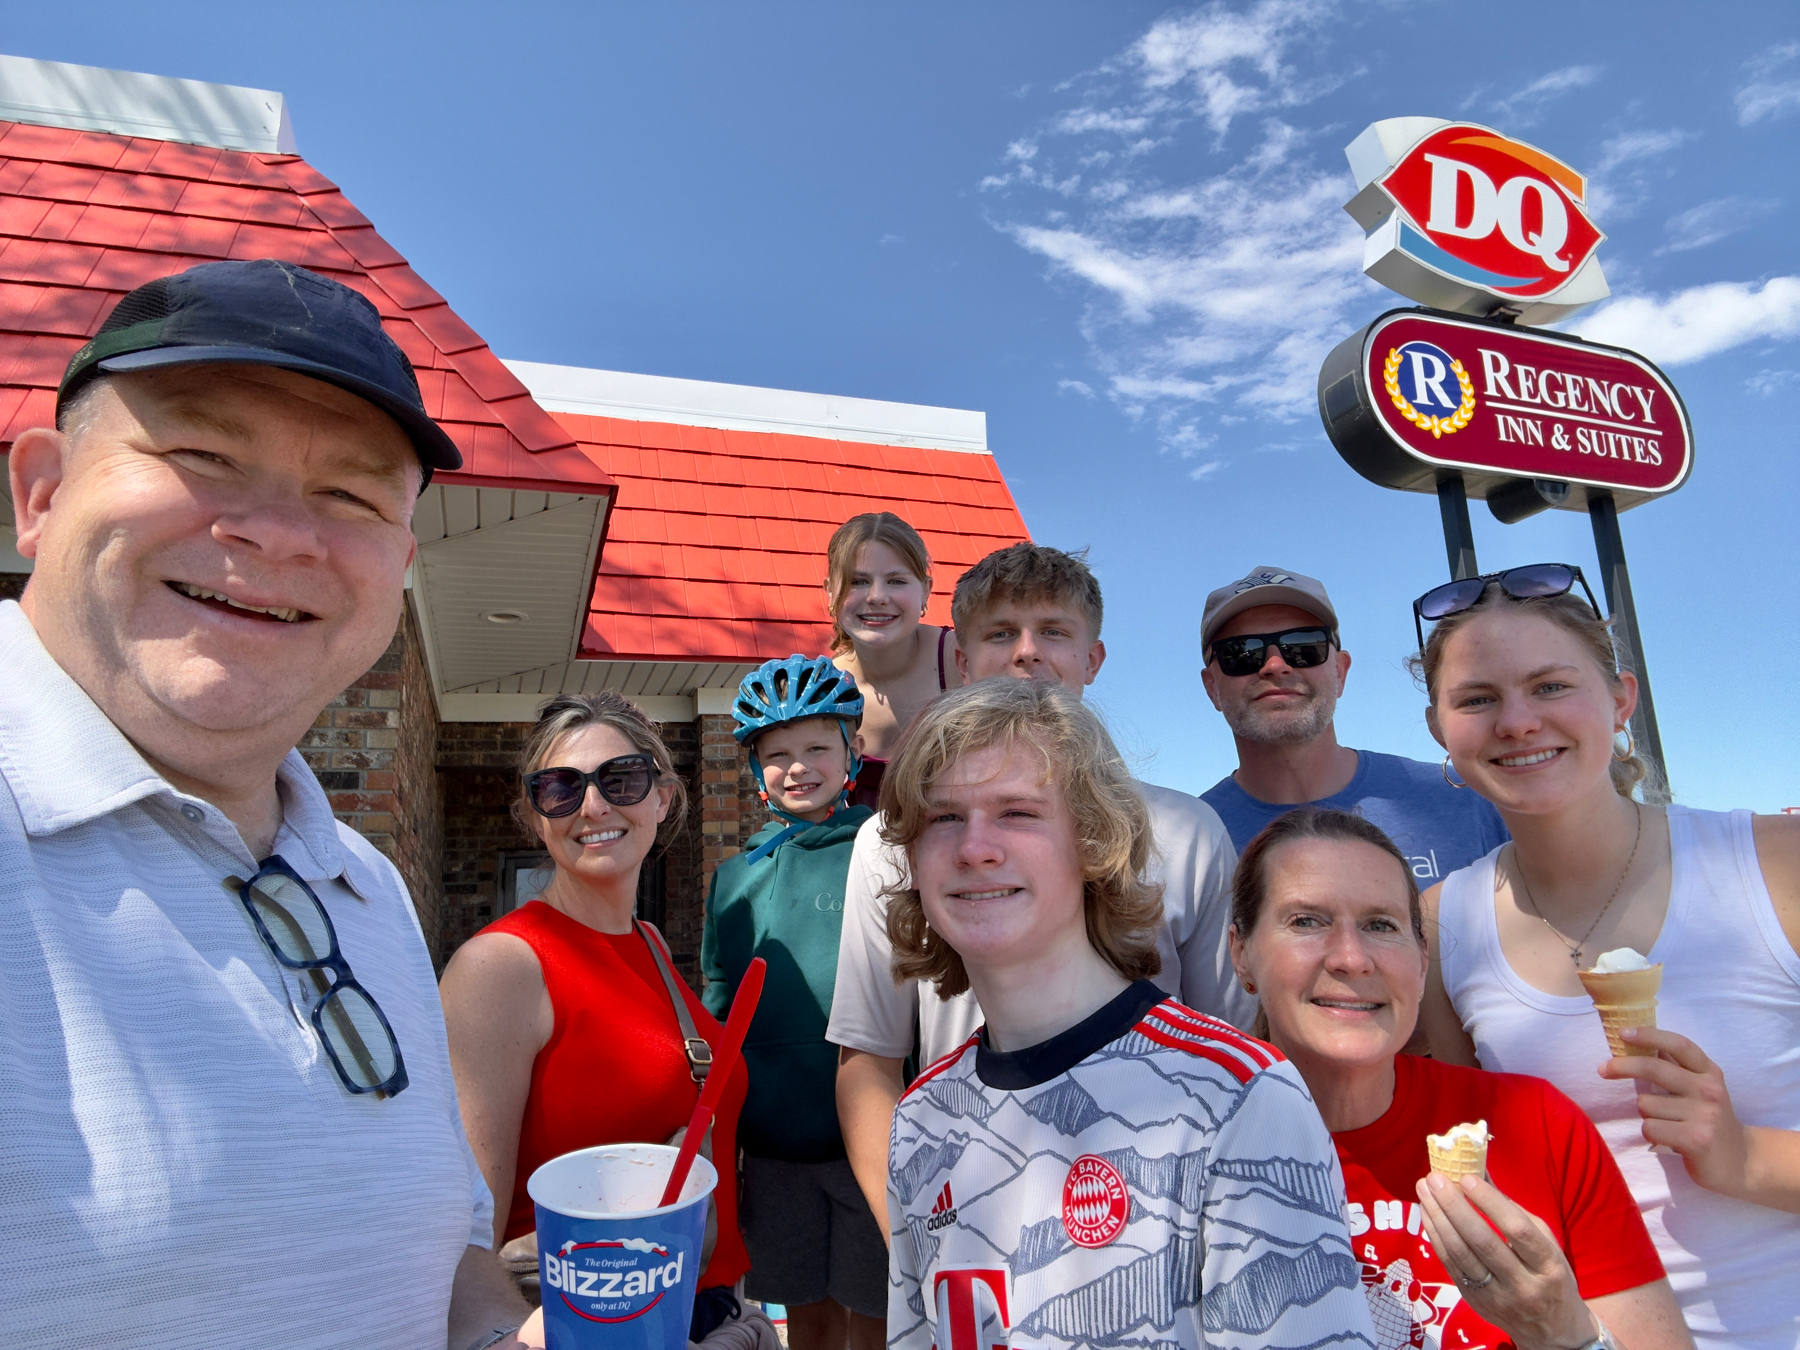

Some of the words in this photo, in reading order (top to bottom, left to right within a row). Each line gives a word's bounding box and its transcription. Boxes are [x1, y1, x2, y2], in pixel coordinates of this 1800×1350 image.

[1424, 153, 1570, 272] DQ
[1405, 350, 1458, 409] R
[1477, 348, 1656, 424] REGENCY
[1494, 414, 1545, 447] INN
[1551, 423, 1572, 451] &
[1576, 427, 1663, 466] SUITES
[1404, 849, 1440, 878] al
[814, 892, 844, 912] Co
[1067, 1170, 1078, 1190] FC
[1078, 1161, 1123, 1200] BAYERN
[927, 1208, 957, 1231] adidas
[545, 1251, 684, 1298] Blizzard
[585, 1257, 600, 1267] The
[601, 1257, 638, 1269] Original
[590, 1302, 608, 1311] only
[618, 1301, 631, 1310] DQ
[934, 1269, 1010, 1350] T
